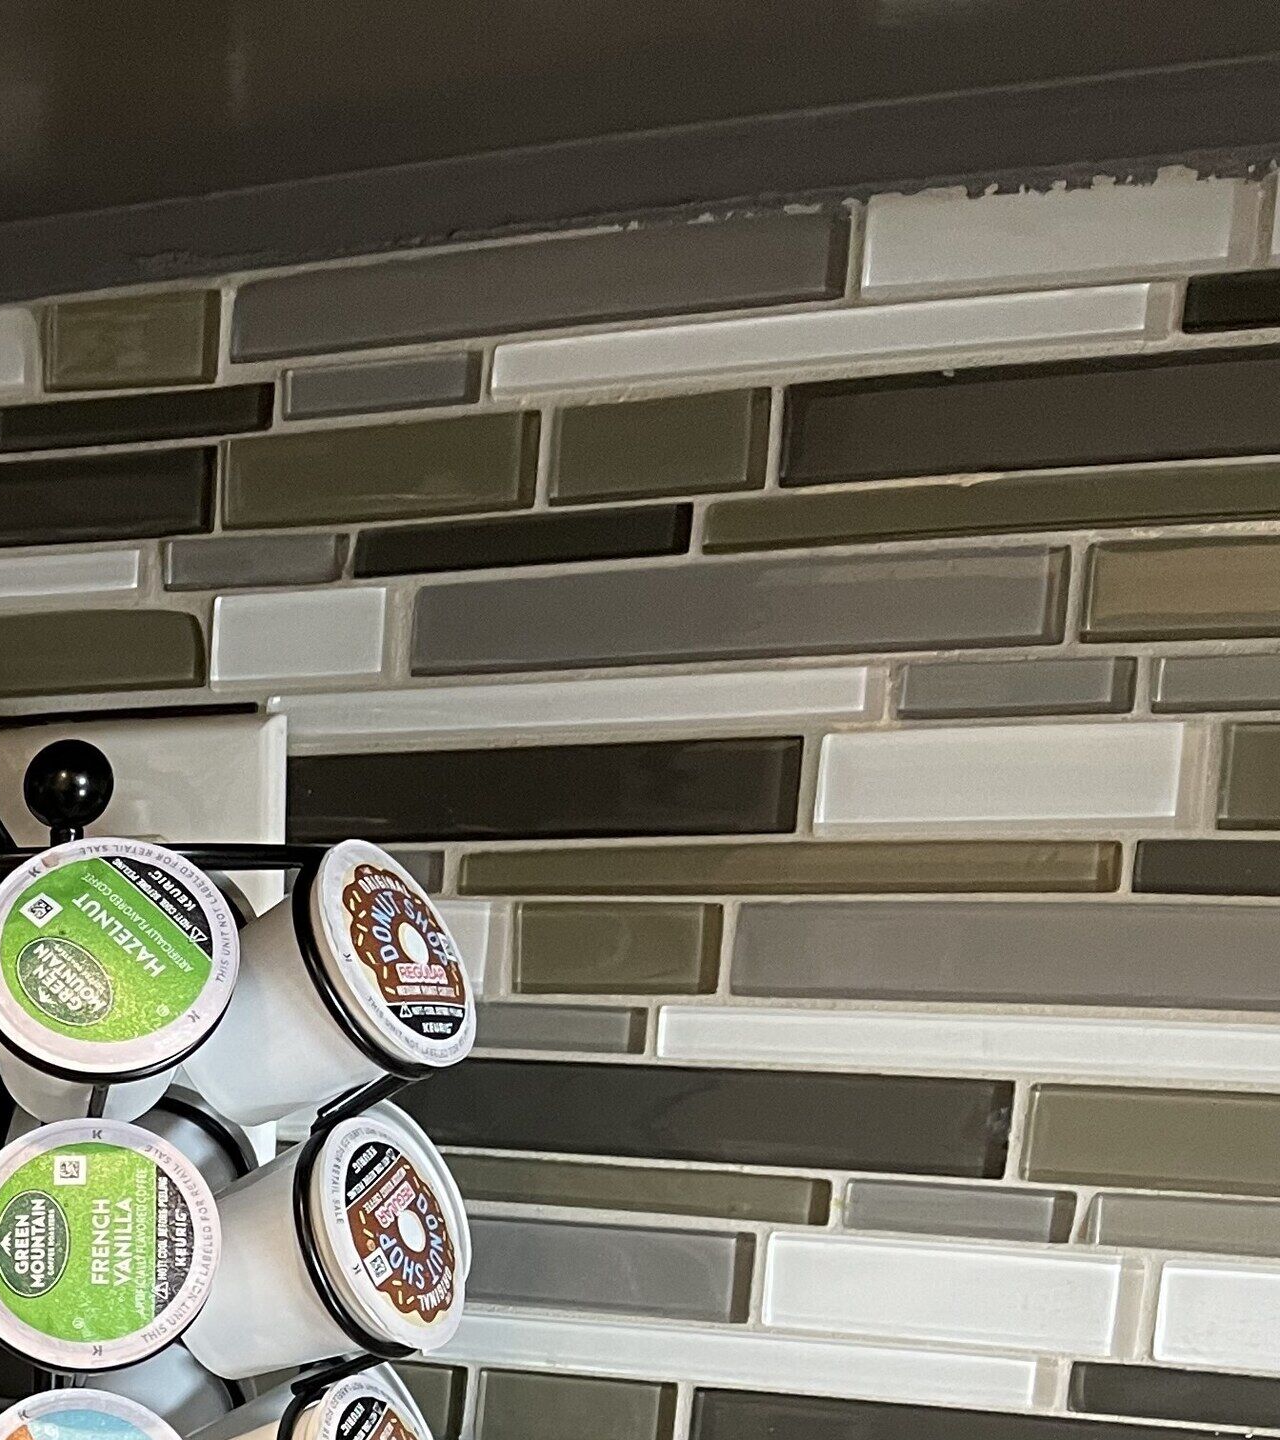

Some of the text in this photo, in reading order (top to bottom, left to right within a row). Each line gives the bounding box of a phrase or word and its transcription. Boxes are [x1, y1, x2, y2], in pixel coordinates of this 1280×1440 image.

[113, 844, 154, 859] RETAIL
[155, 853, 179, 869] FOR
[148, 870, 197, 911] KEURIG
[180, 866, 218, 906] LABELED
[358, 875, 411, 898] ORIGINAL
[72, 893, 166, 979] HAZELNUT
[108, 895, 149, 933] FLAVORED
[214, 906, 228, 928] NOT
[371, 891, 401, 963] DONUT
[220, 931, 231, 957] UNIT
[32, 943, 108, 1014] MOUNTAIN
[32, 967, 83, 1011] GREEN
[215, 959, 229, 984] THIS
[135, 1167, 147, 1201] COFFEE
[15, 1214, 30, 1274] GREEN
[30, 1199, 45, 1287] MOUNTAIN
[91, 1199, 110, 1285] FRENCH
[113, 1197, 134, 1287] VANILLA
[135, 1202, 147, 1252] FLAVORED
[142, 1144, 212, 1343] THIS UNIT NOT LABELED FOR RETAIL SALE
[174, 1209, 187, 1266] KEURIG
[379, 1194, 444, 1290] DONUT SHOP
[417, 1266, 453, 1311] ORIGINAL
